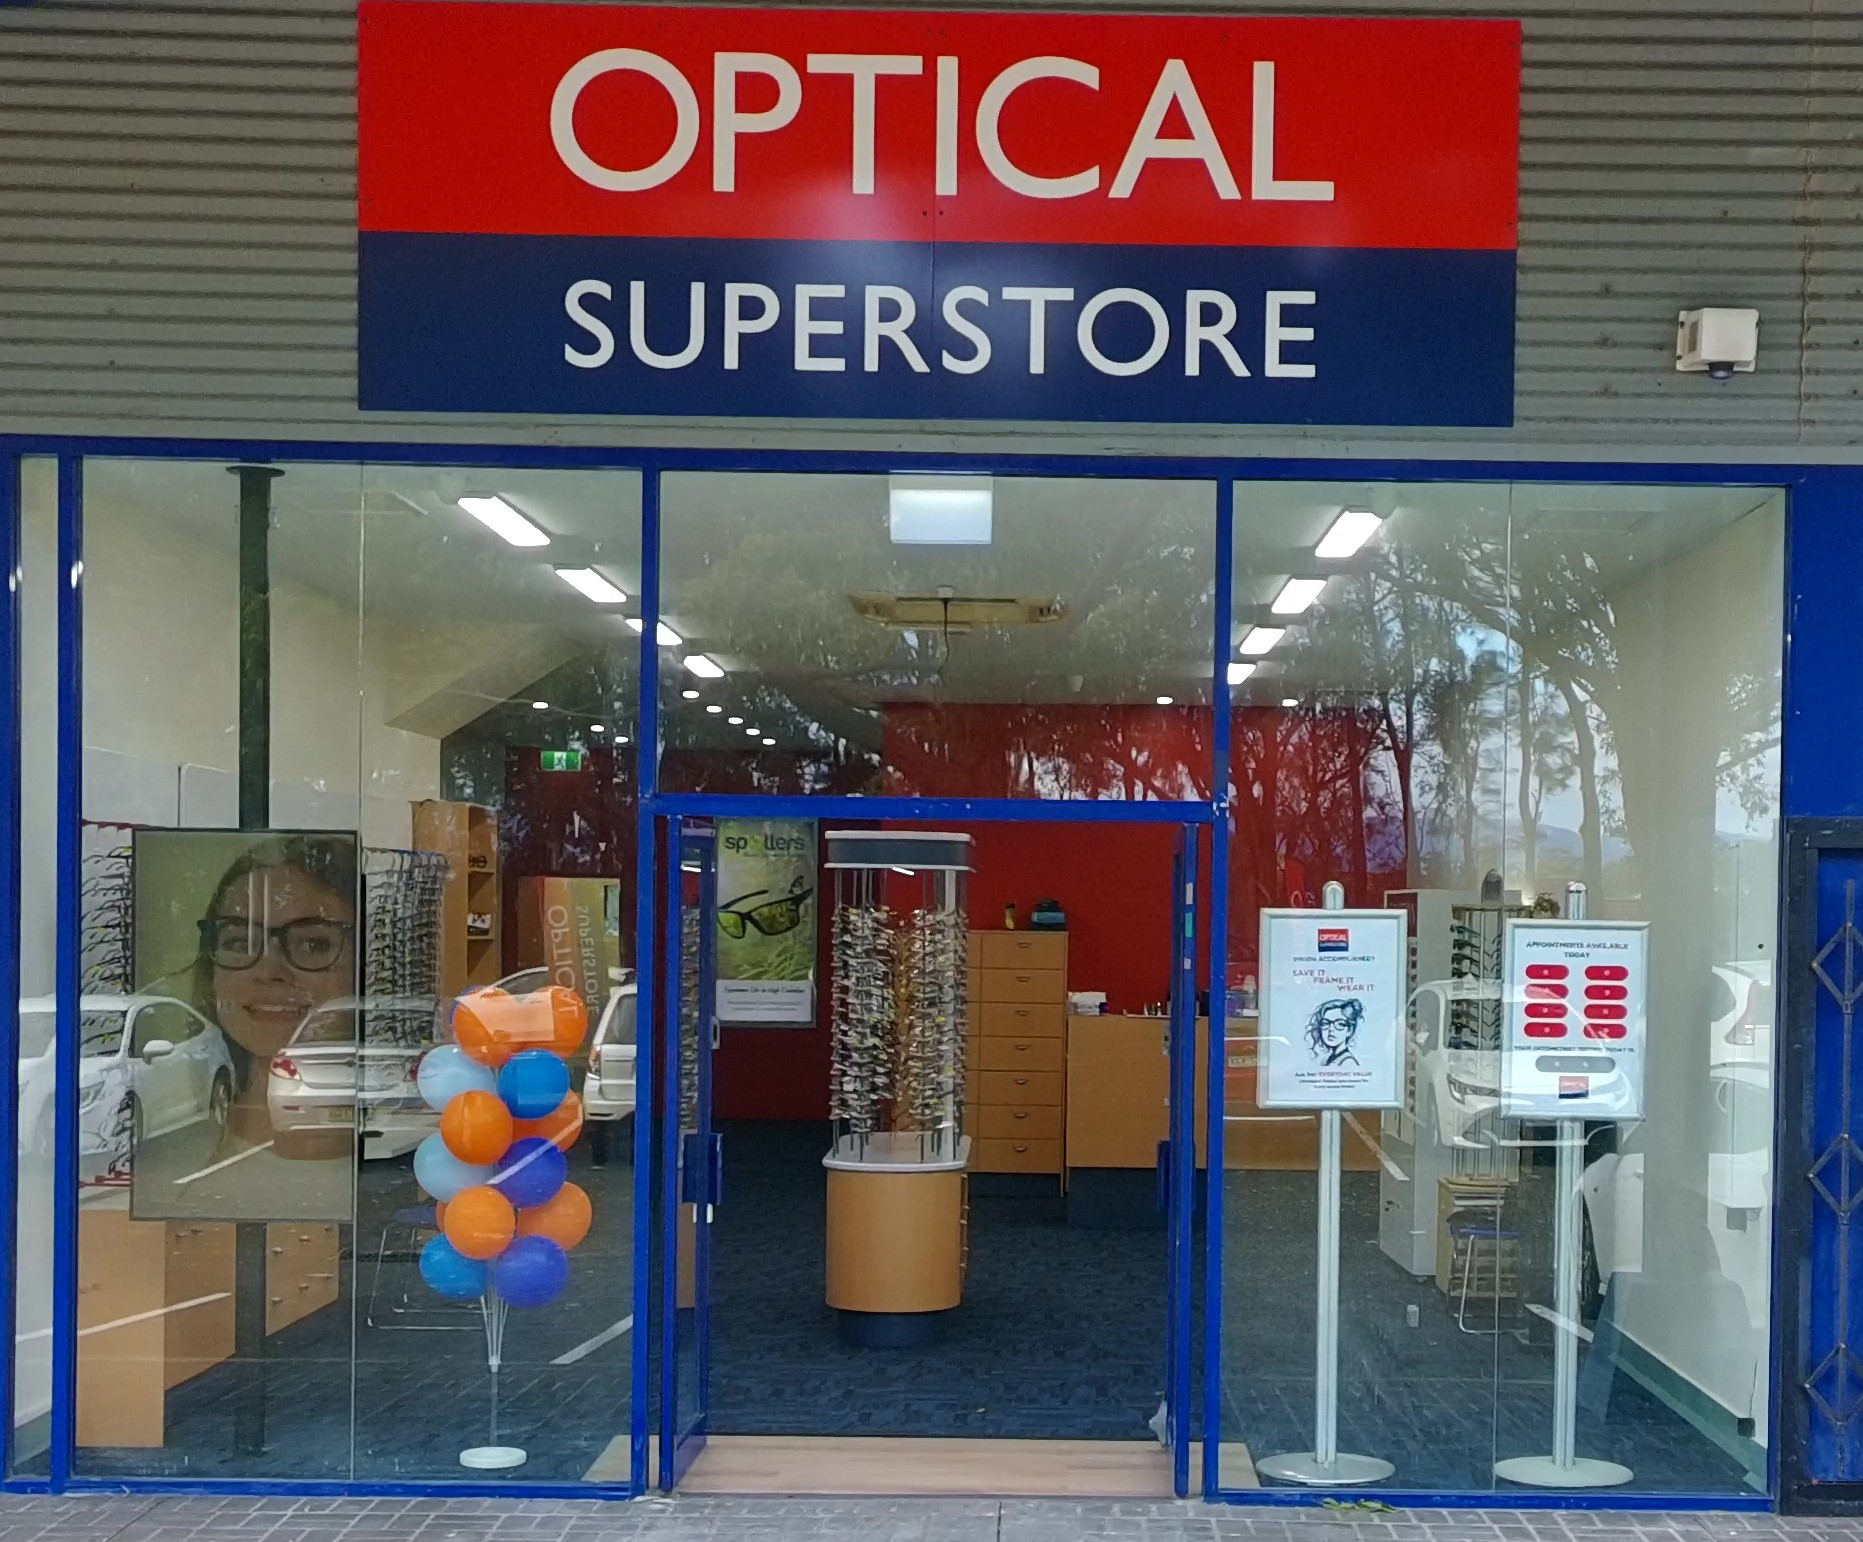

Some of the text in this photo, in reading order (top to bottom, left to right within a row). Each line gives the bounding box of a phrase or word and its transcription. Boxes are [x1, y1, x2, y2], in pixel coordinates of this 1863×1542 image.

[550, 48, 1335, 202] OPTICAL
[563, 279, 1317, 379] SUPERSTORE
[1292, 969, 1326, 977] SAVE IT
[1312, 976, 1355, 985] FRAME IT
[1337, 984, 1375, 992] WEAR IT
